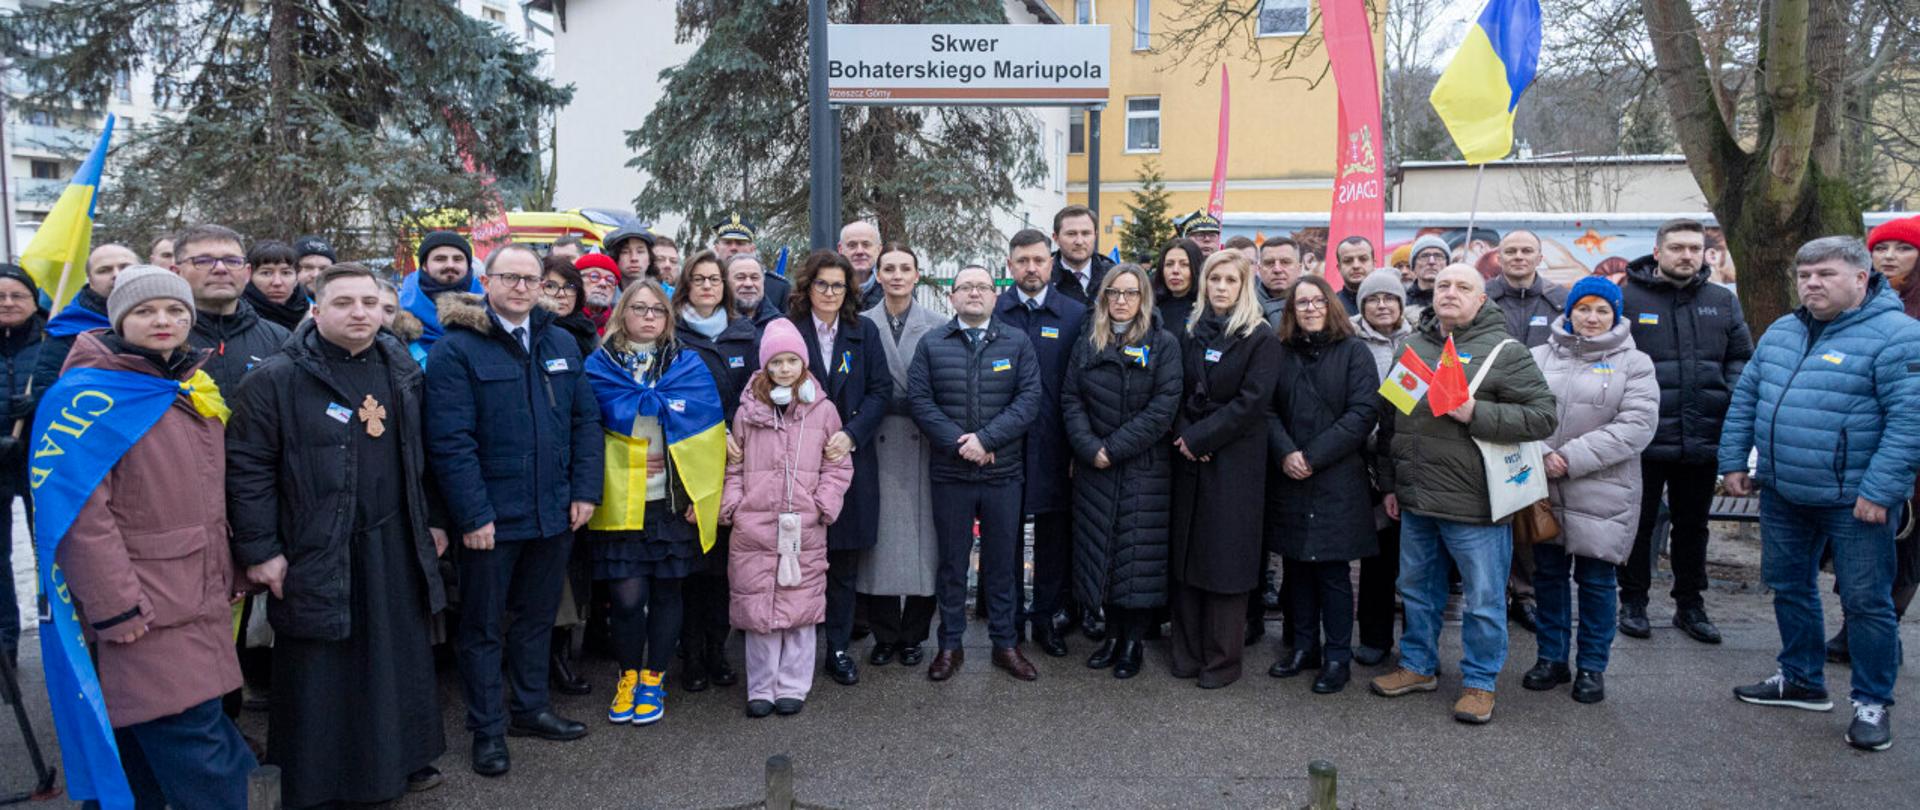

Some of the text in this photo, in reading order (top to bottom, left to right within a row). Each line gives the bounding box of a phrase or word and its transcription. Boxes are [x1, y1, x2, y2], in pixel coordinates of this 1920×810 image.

[931, 34, 999, 52] Skwer
[829, 60, 1101, 82] Bohaterskiego Mariupola
